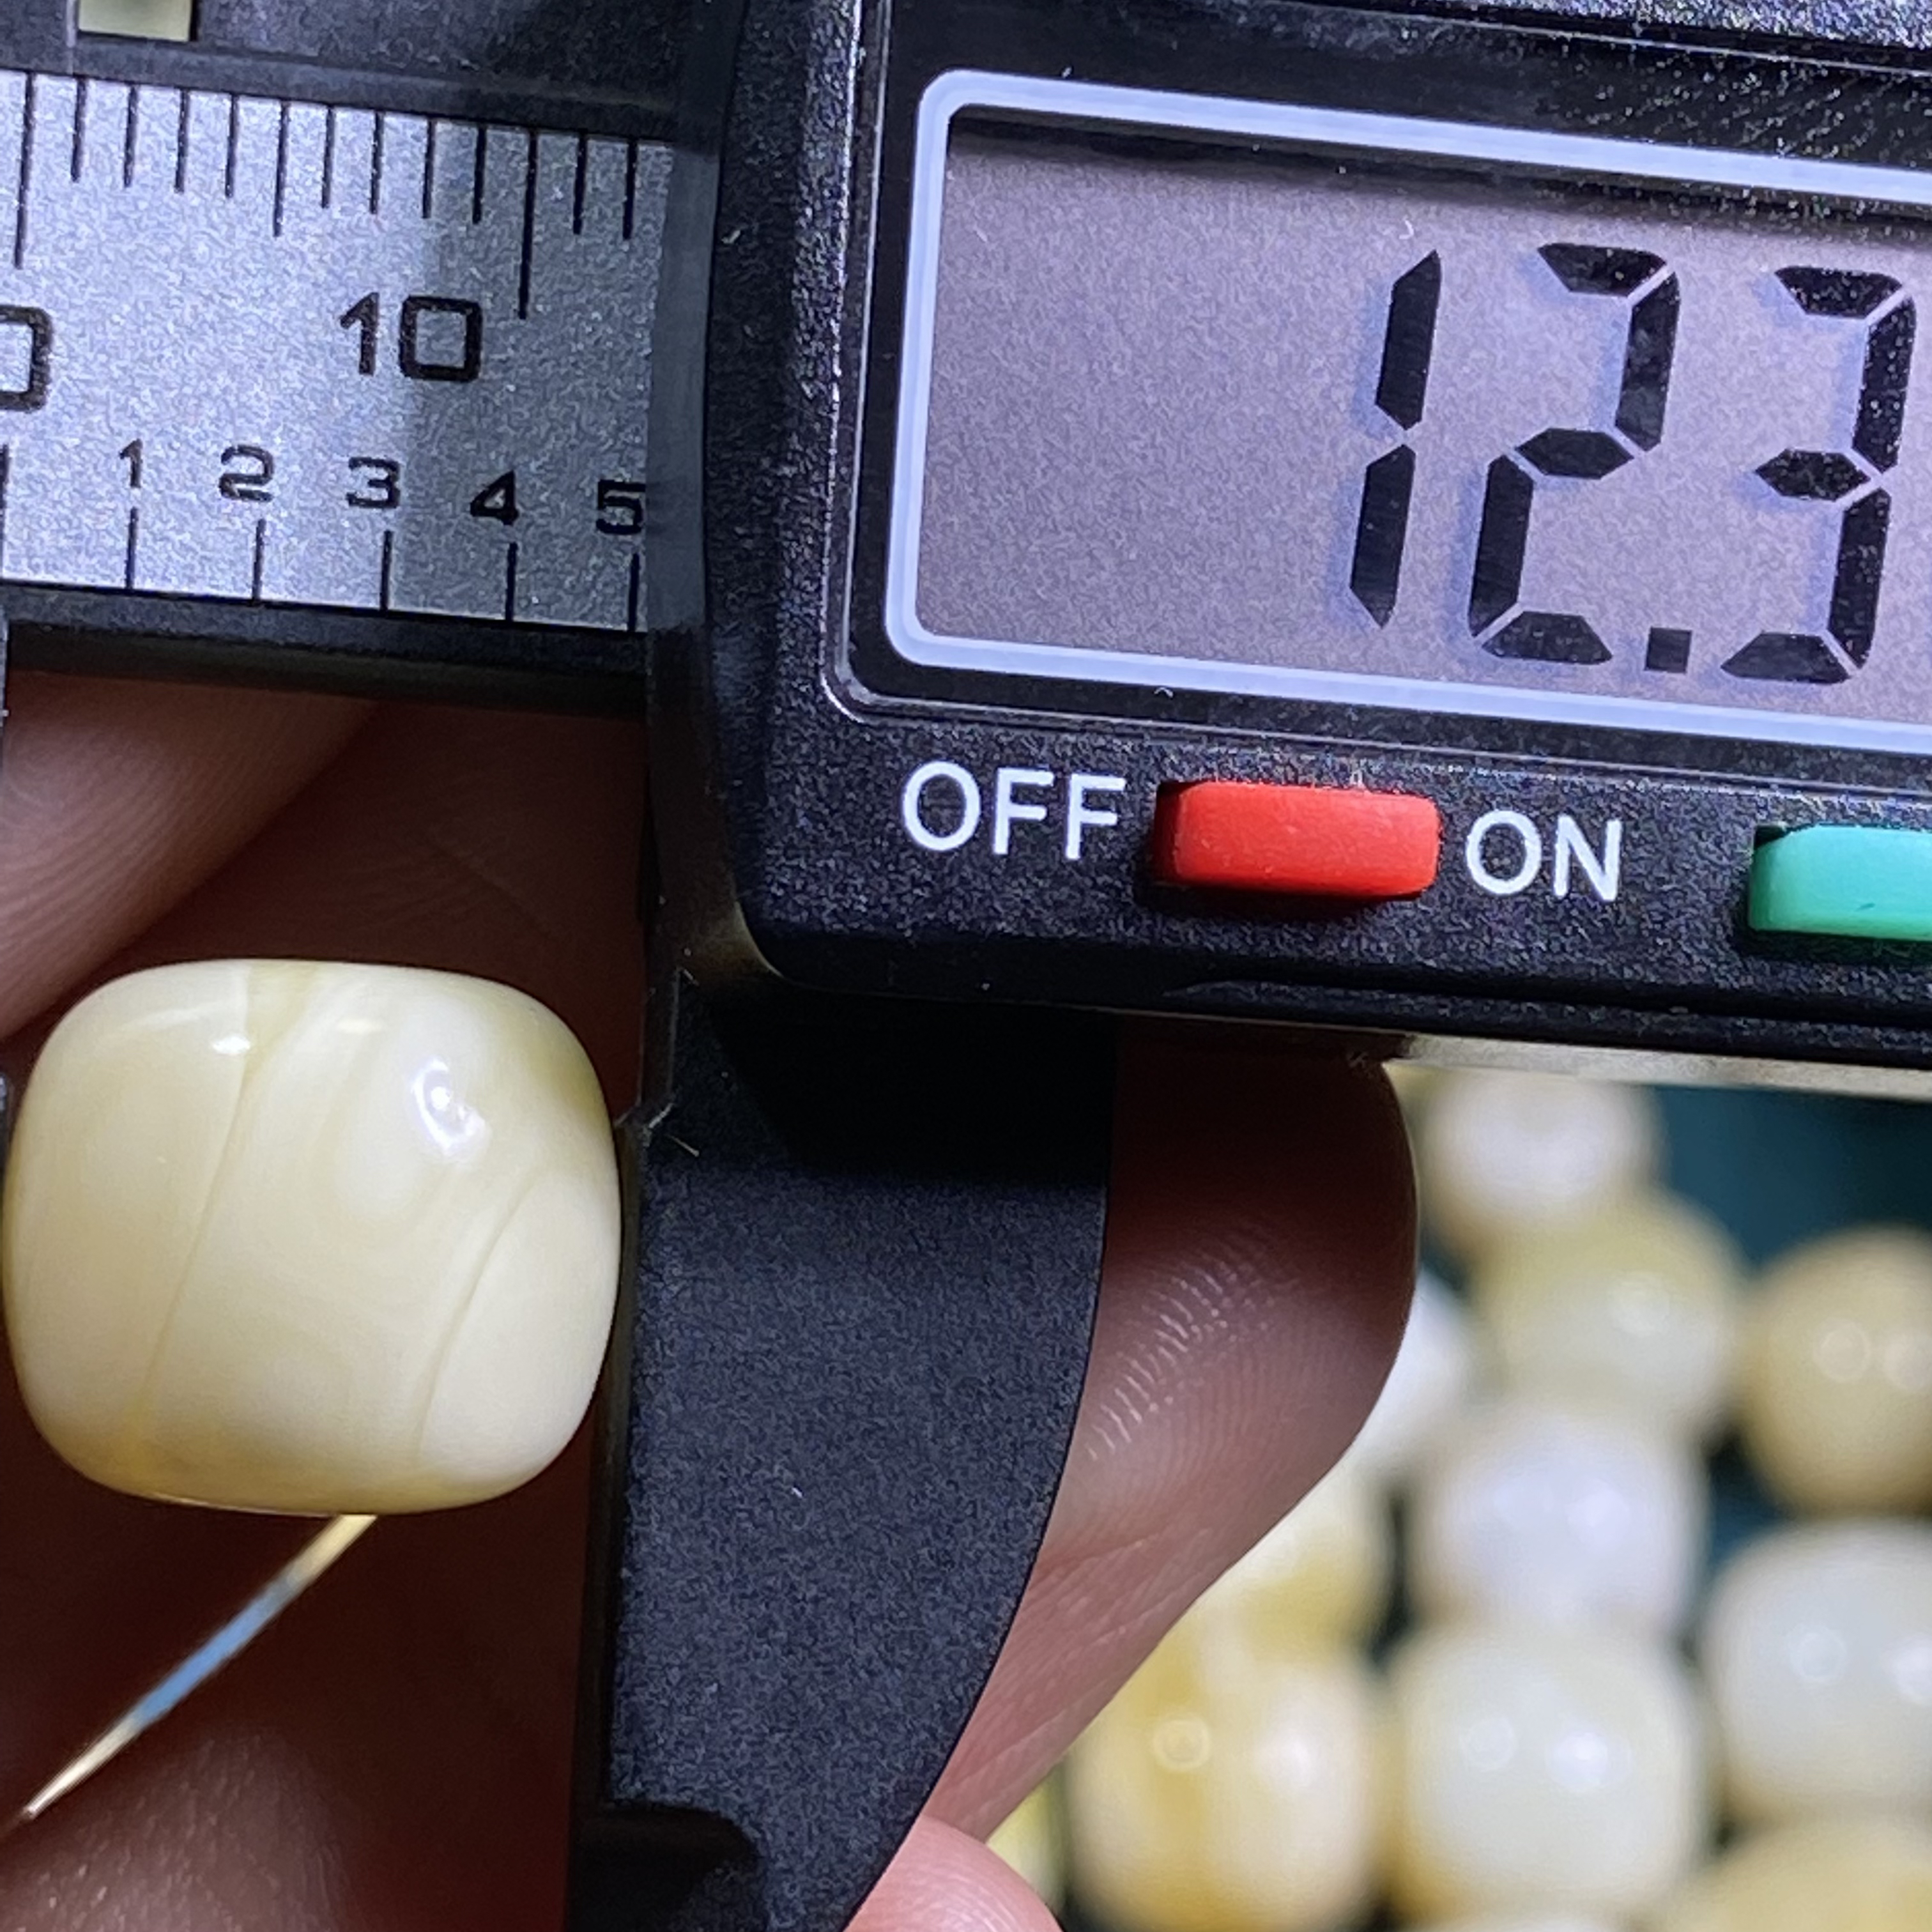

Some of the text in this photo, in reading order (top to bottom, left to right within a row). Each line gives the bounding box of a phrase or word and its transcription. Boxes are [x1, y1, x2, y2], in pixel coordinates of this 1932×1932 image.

[340, 292, 483, 383] 10
[119, 438, 646, 535] 1 2 3 4 5
[1349, 242, 1917, 684] 12.3
[902, 762, 1126, 860] OFF
[1466, 809, 1623, 901] ON
